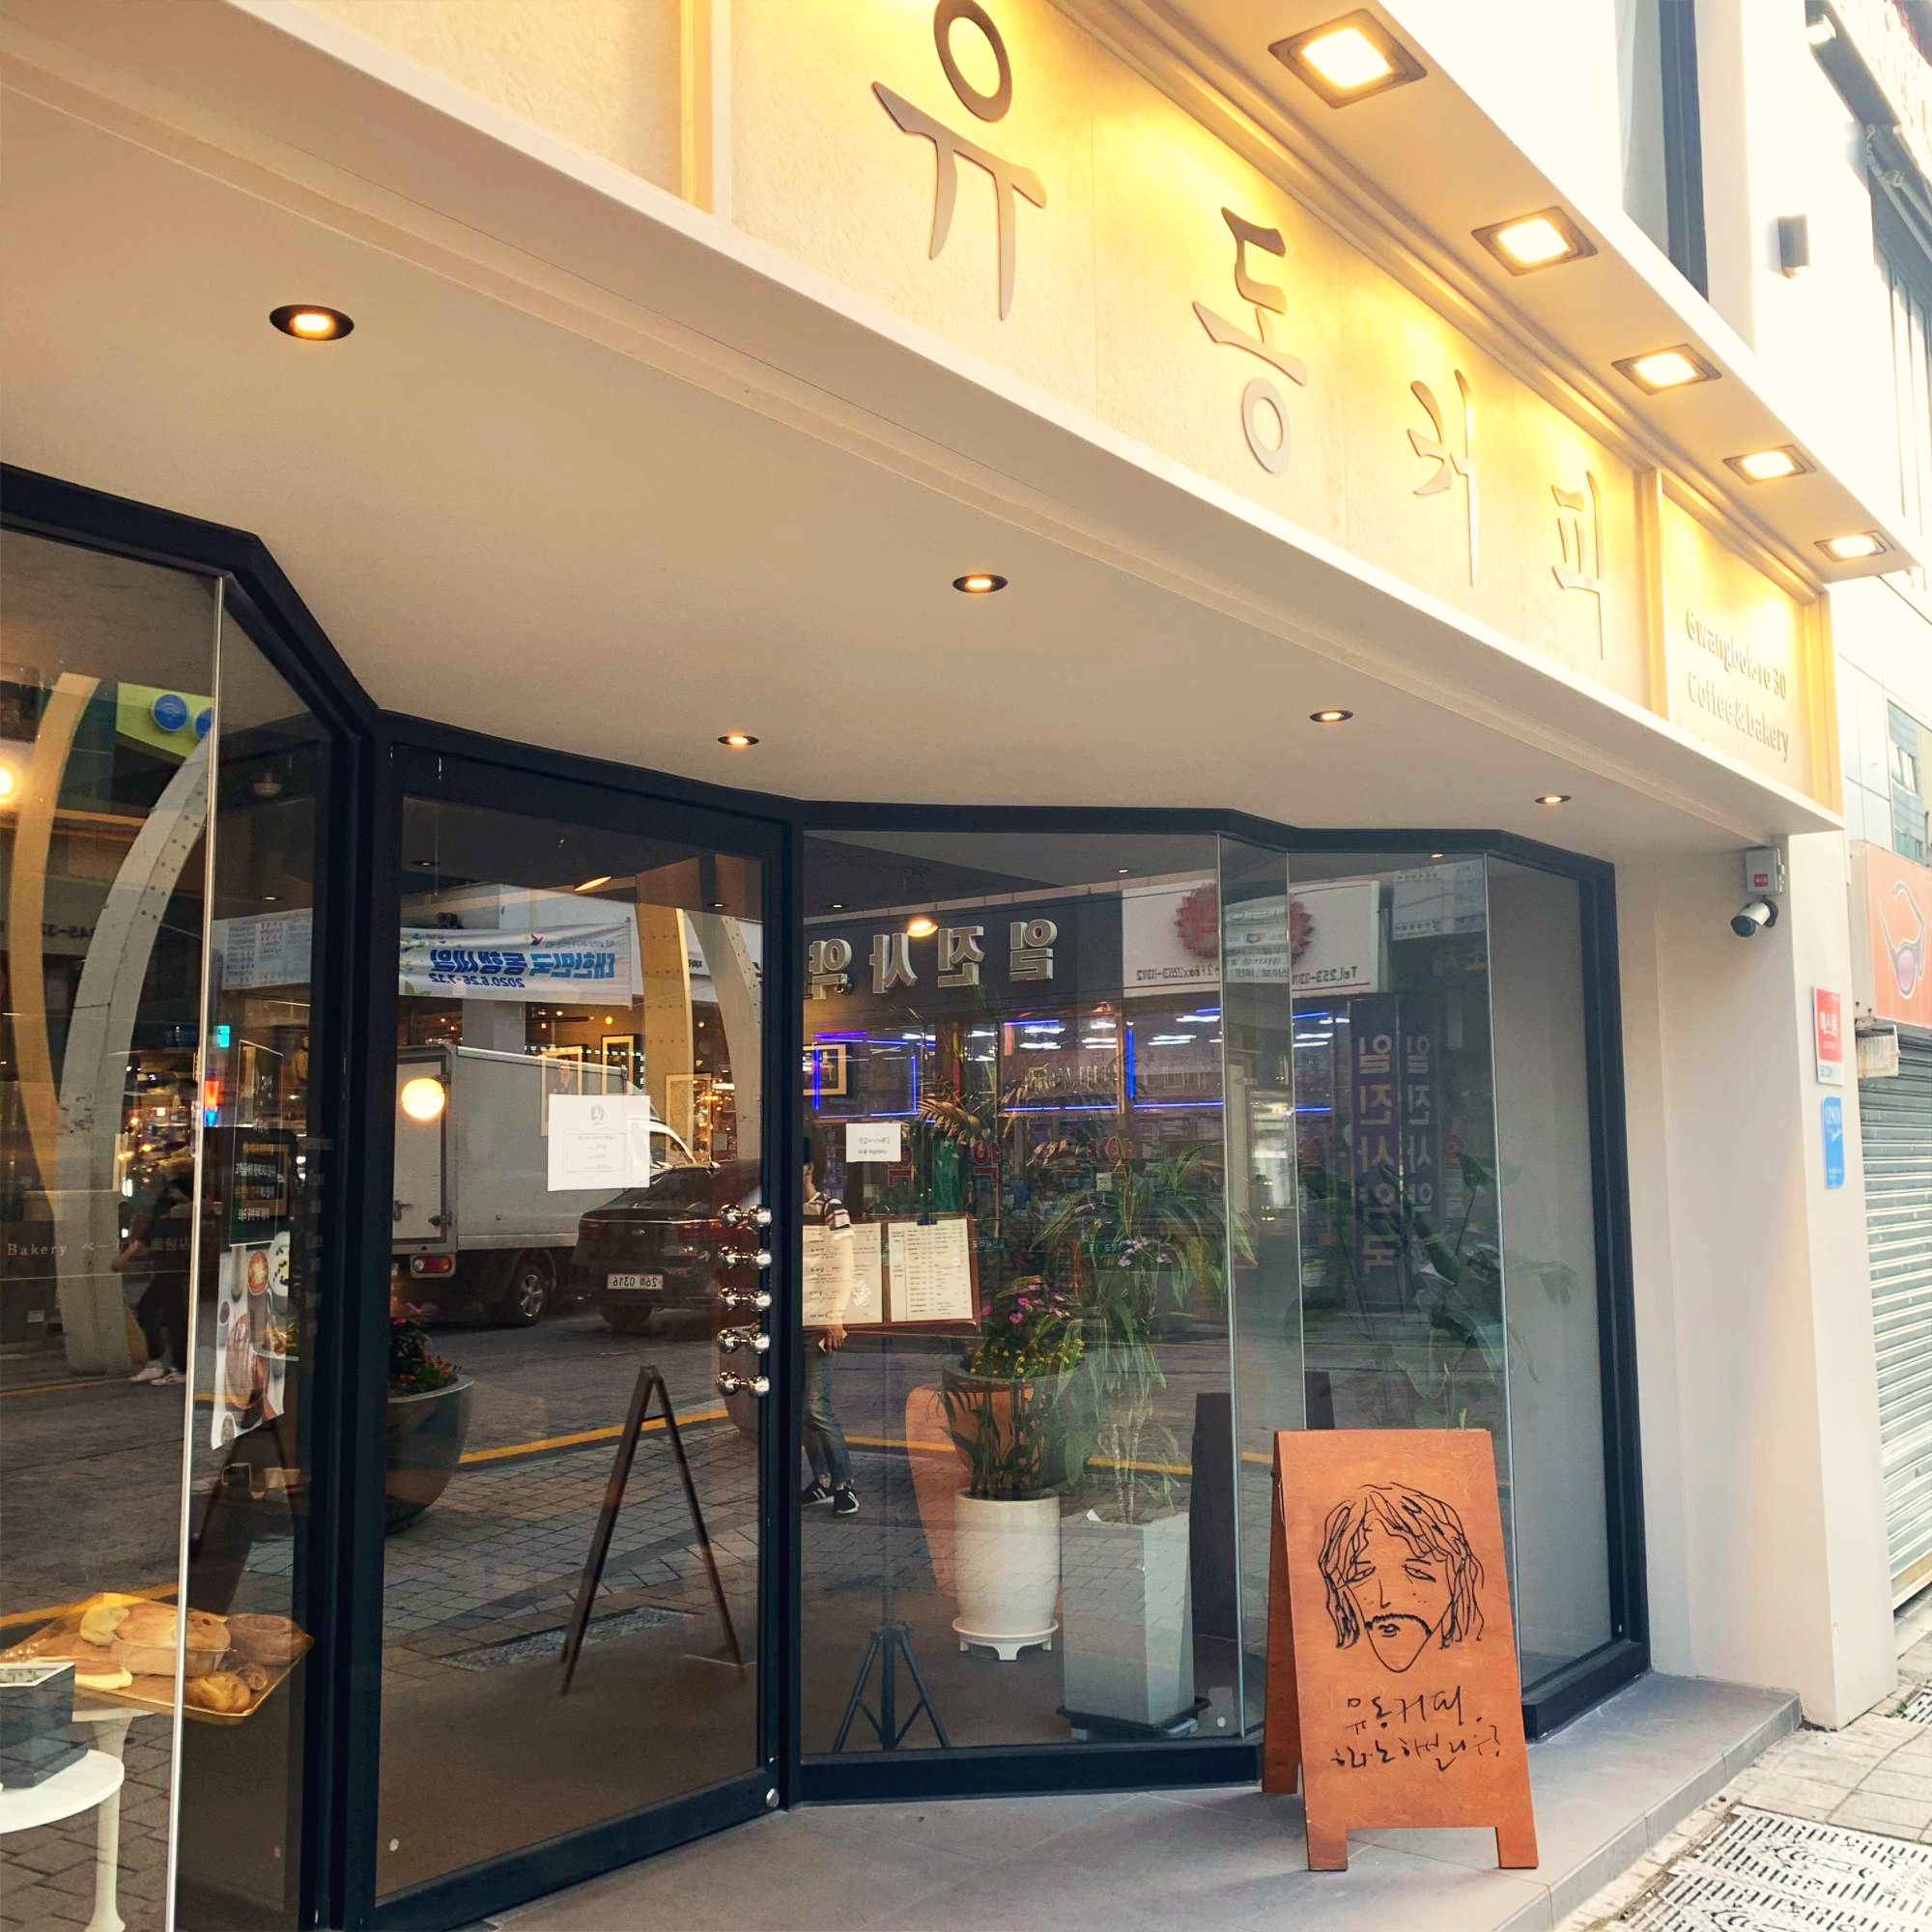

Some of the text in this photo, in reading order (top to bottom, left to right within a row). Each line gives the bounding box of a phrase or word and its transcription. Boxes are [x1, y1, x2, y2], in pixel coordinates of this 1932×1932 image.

[1686, 609, 1787, 700] Gwangbok-ro 30
[7, 1241, 69, 1257] Bakery
